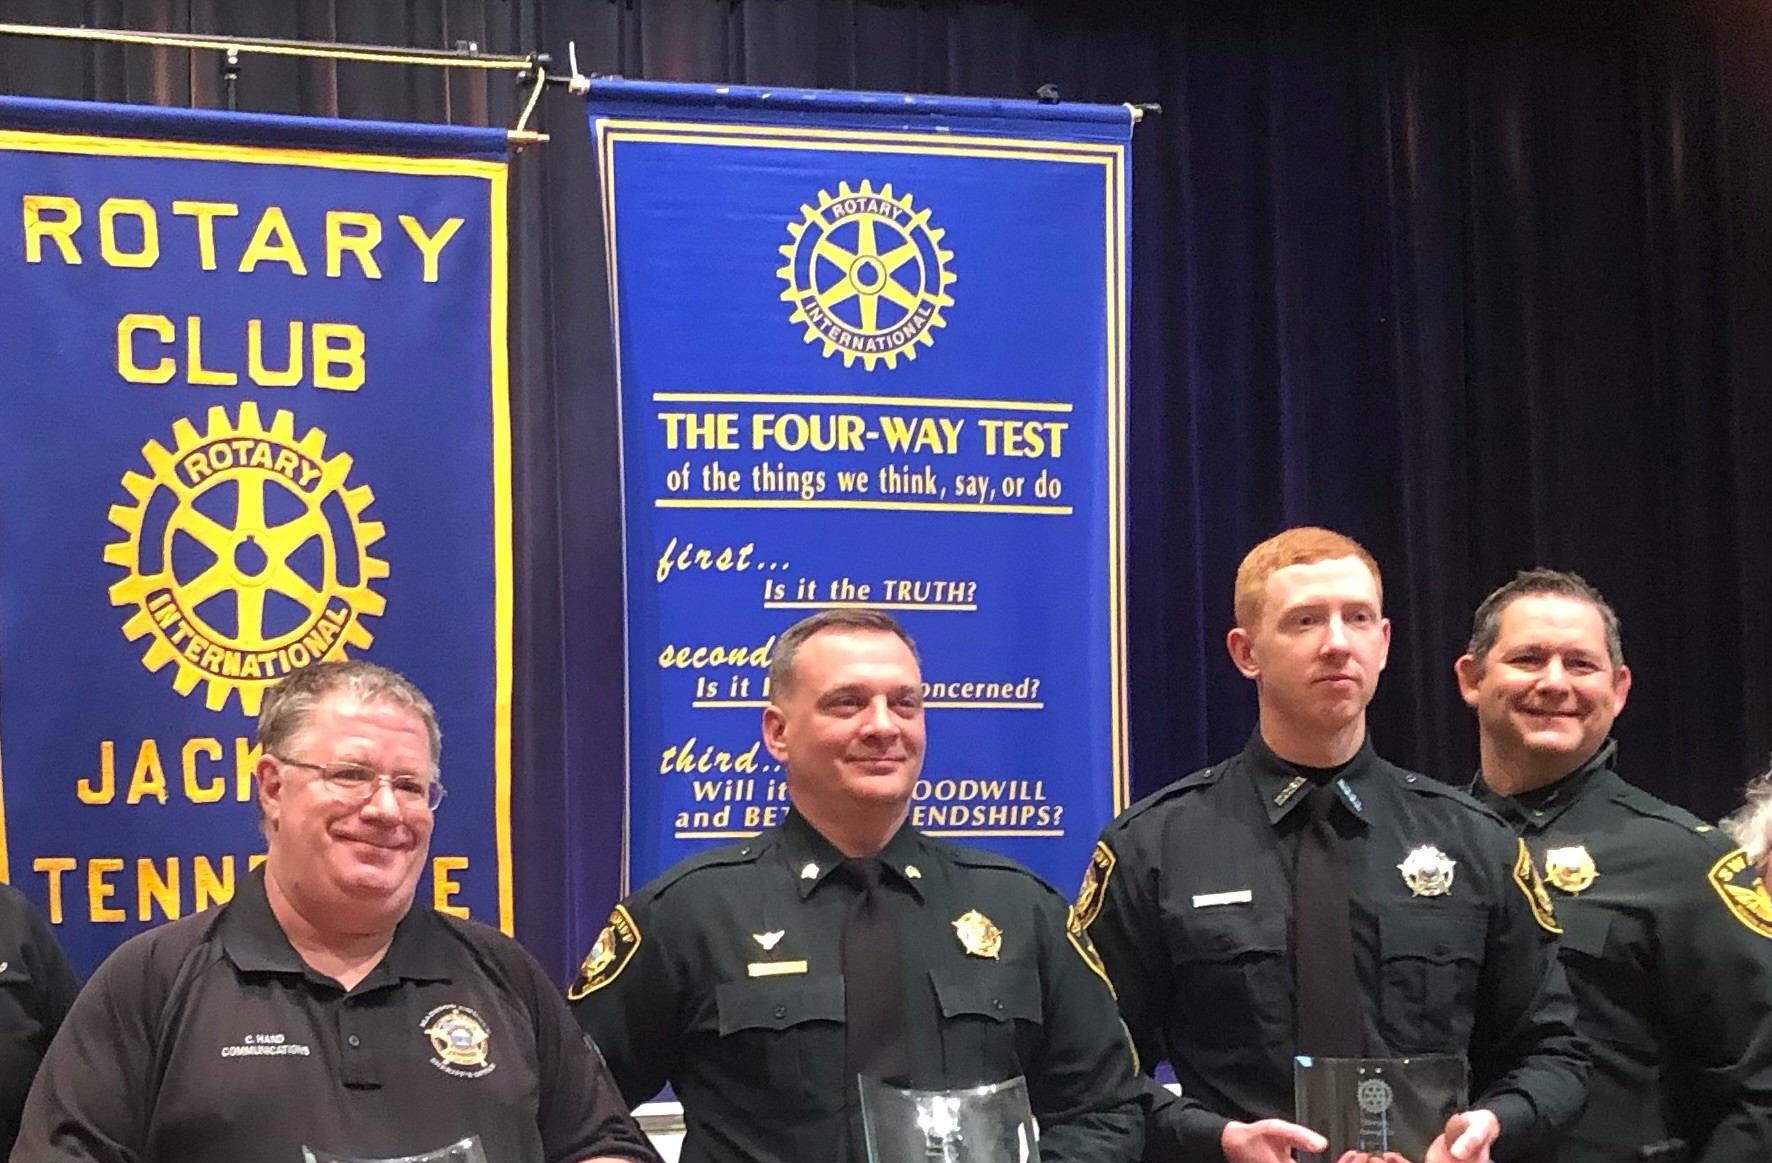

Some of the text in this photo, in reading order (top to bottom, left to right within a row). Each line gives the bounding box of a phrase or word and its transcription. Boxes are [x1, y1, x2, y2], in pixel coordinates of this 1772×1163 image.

[832, 200, 903, 219] ROTARY
[22, 194, 465, 283] ROTARY
[805, 301, 932, 352] INTERNATIONAL
[117, 313, 366, 392] CLUB
[657, 412, 1069, 458] THE FOUR-WAY TEST
[183, 440, 324, 485] ROTARY
[666, 461, 1062, 504] of the things we think, say, or do
[764, 577, 978, 603] Is it the TRUTH?
[148, 592, 349, 678] INTERNATIONAL
[696, 676, 719, 698] Is
[729, 674, 750, 698] it
[921, 676, 1041, 699] oncerned?
[76, 737, 264, 804] JACK
[692, 778, 788, 802] Will it
[911, 779, 1047, 802] OODWILL
[674, 805, 731, 828] and
[911, 805, 1065, 827] ENDSHIPS?
